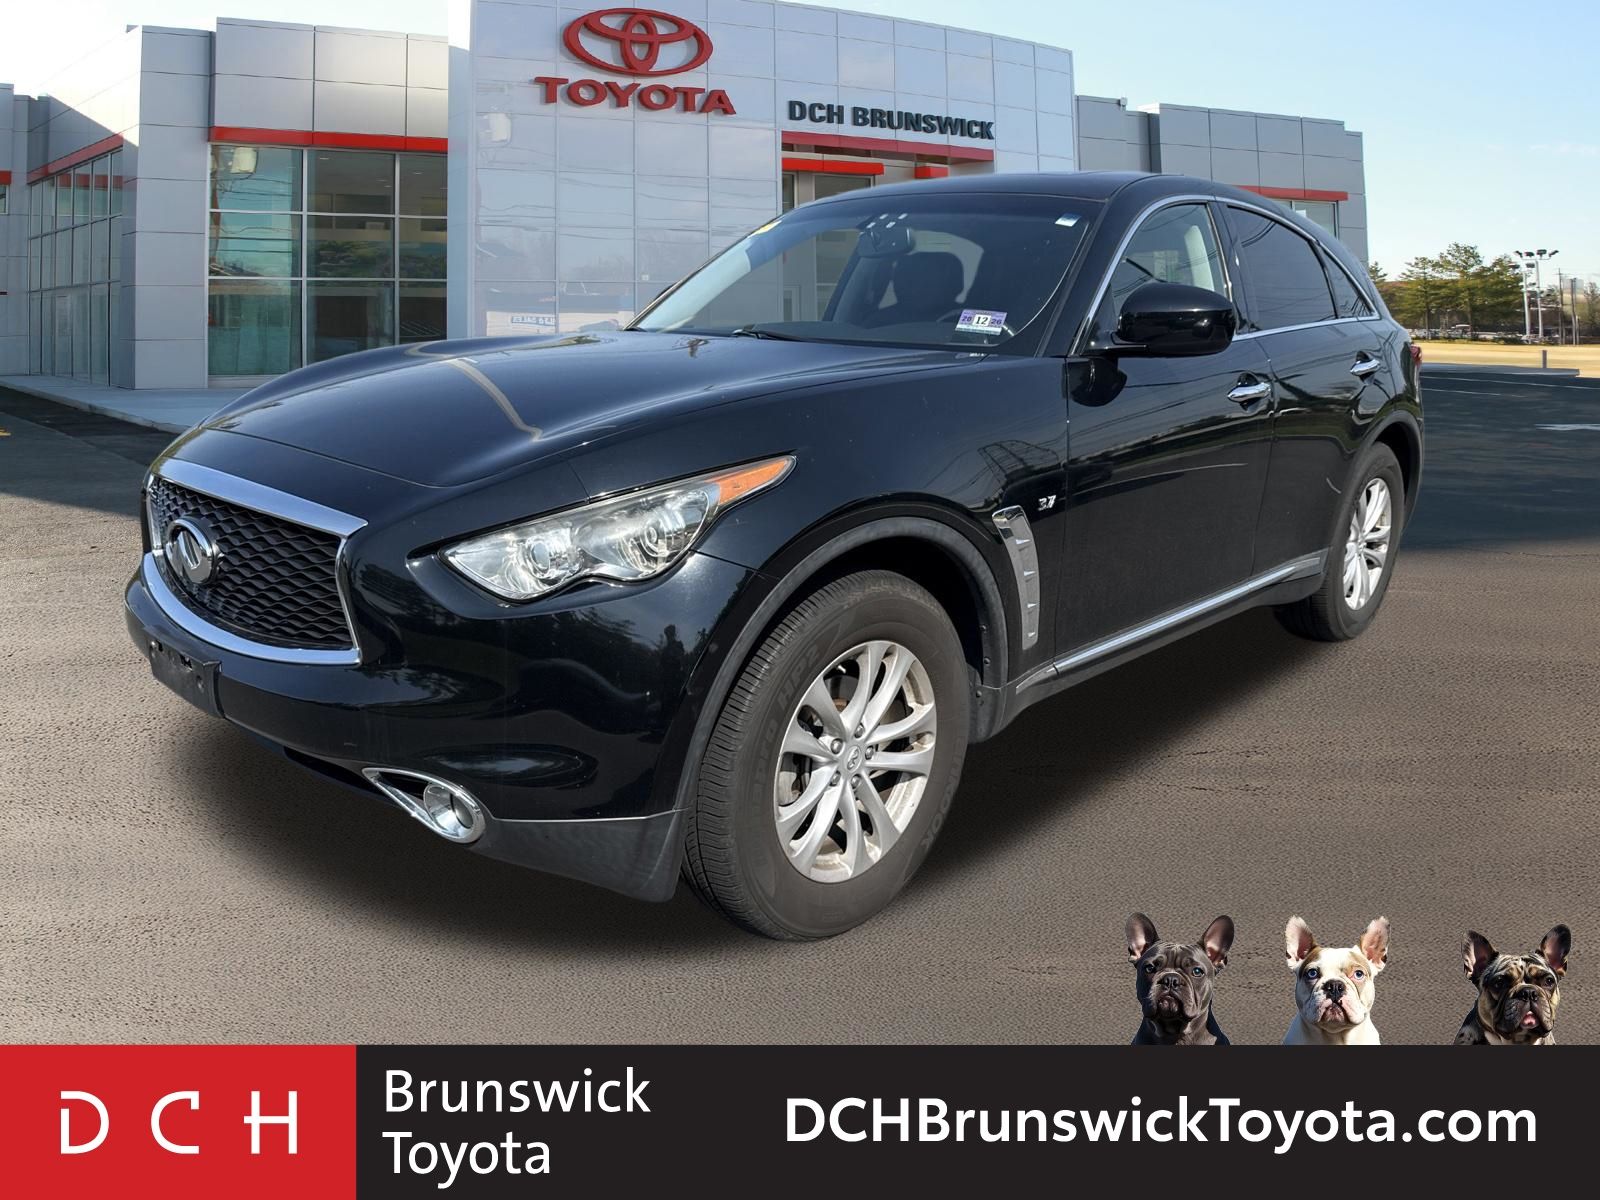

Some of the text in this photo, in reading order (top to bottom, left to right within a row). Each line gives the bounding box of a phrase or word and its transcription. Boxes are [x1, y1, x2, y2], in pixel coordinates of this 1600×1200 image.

[534, 76, 736, 116] TOYOTA
[788, 99, 995, 141] DCH BRUNSWICK
[976, 316, 989, 325] 12
